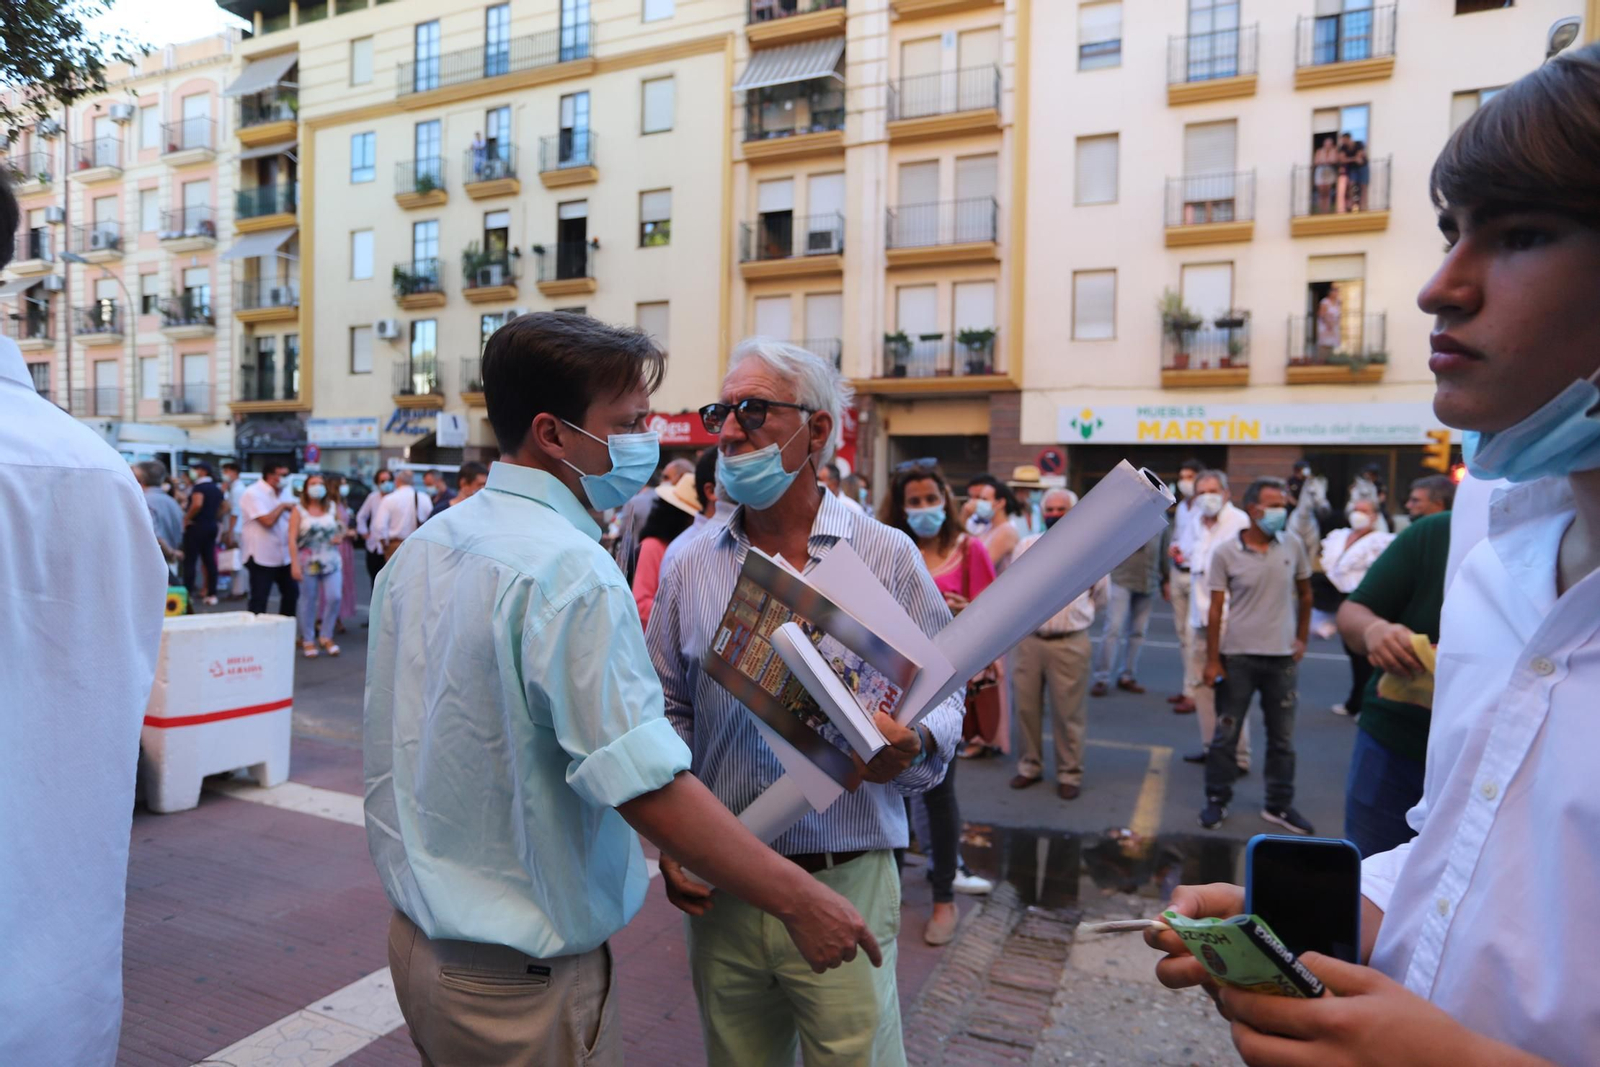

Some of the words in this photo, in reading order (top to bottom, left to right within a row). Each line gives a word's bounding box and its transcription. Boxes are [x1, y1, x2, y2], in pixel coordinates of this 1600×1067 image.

[1137, 406, 1205, 417] MUEBLES
[1138, 414, 1260, 440] MARTÍN
[1284, 423, 1327, 435] tienda
[1331, 423, 1350, 435] del
[1354, 423, 1421, 435] descanso
[1255, 925, 1294, 963] provoca
[1292, 957, 1323, 994] Fumar
